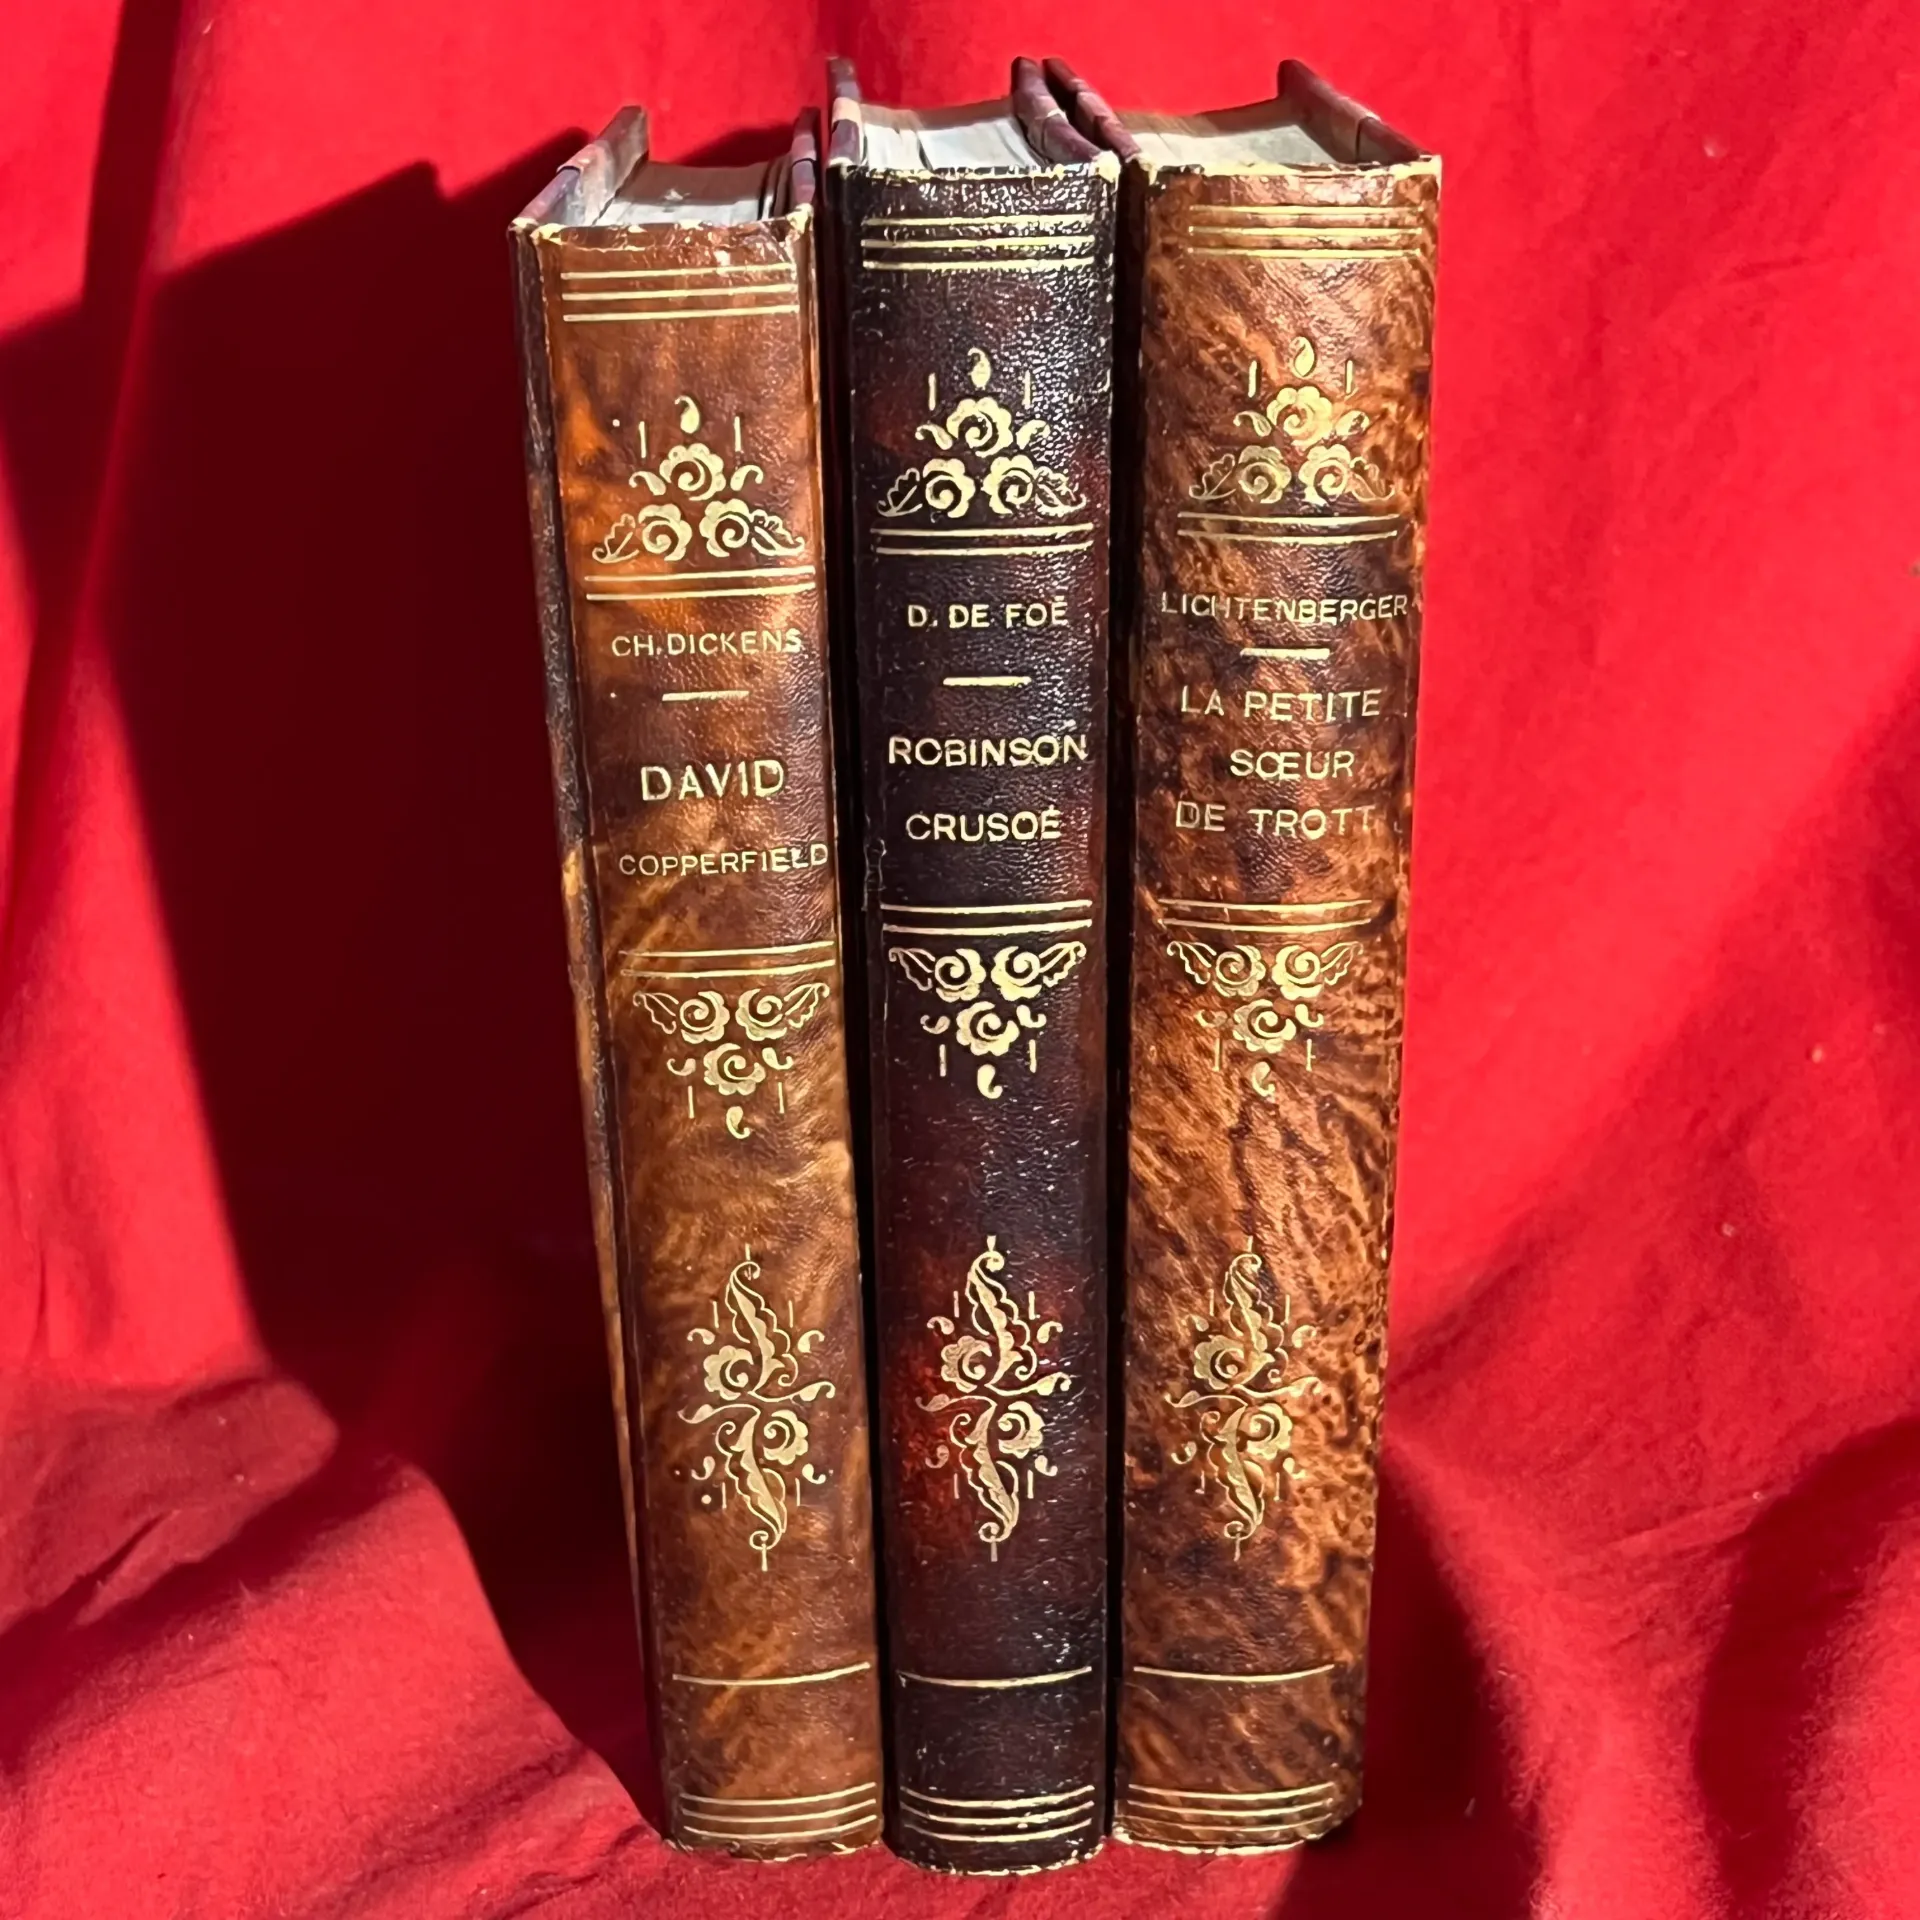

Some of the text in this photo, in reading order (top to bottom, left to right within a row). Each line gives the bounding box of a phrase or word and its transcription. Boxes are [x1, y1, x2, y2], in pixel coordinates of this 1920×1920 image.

[907, 604, 938, 628] D.
[949, 604, 990, 628] DE
[1161, 592, 1408, 626] LICHTENBERGER
[1181, 685, 1382, 723] LA PETITE
[888, 735, 1088, 767] ROBINSON
[1229, 749, 1354, 781] SŒUR
[640, 759, 785, 801] DAVID
[905, 805, 1062, 842] CRUSOÉ
[1175, 801, 1376, 840] DE TROTT
[619, 844, 829, 877] COPPERFIELD
